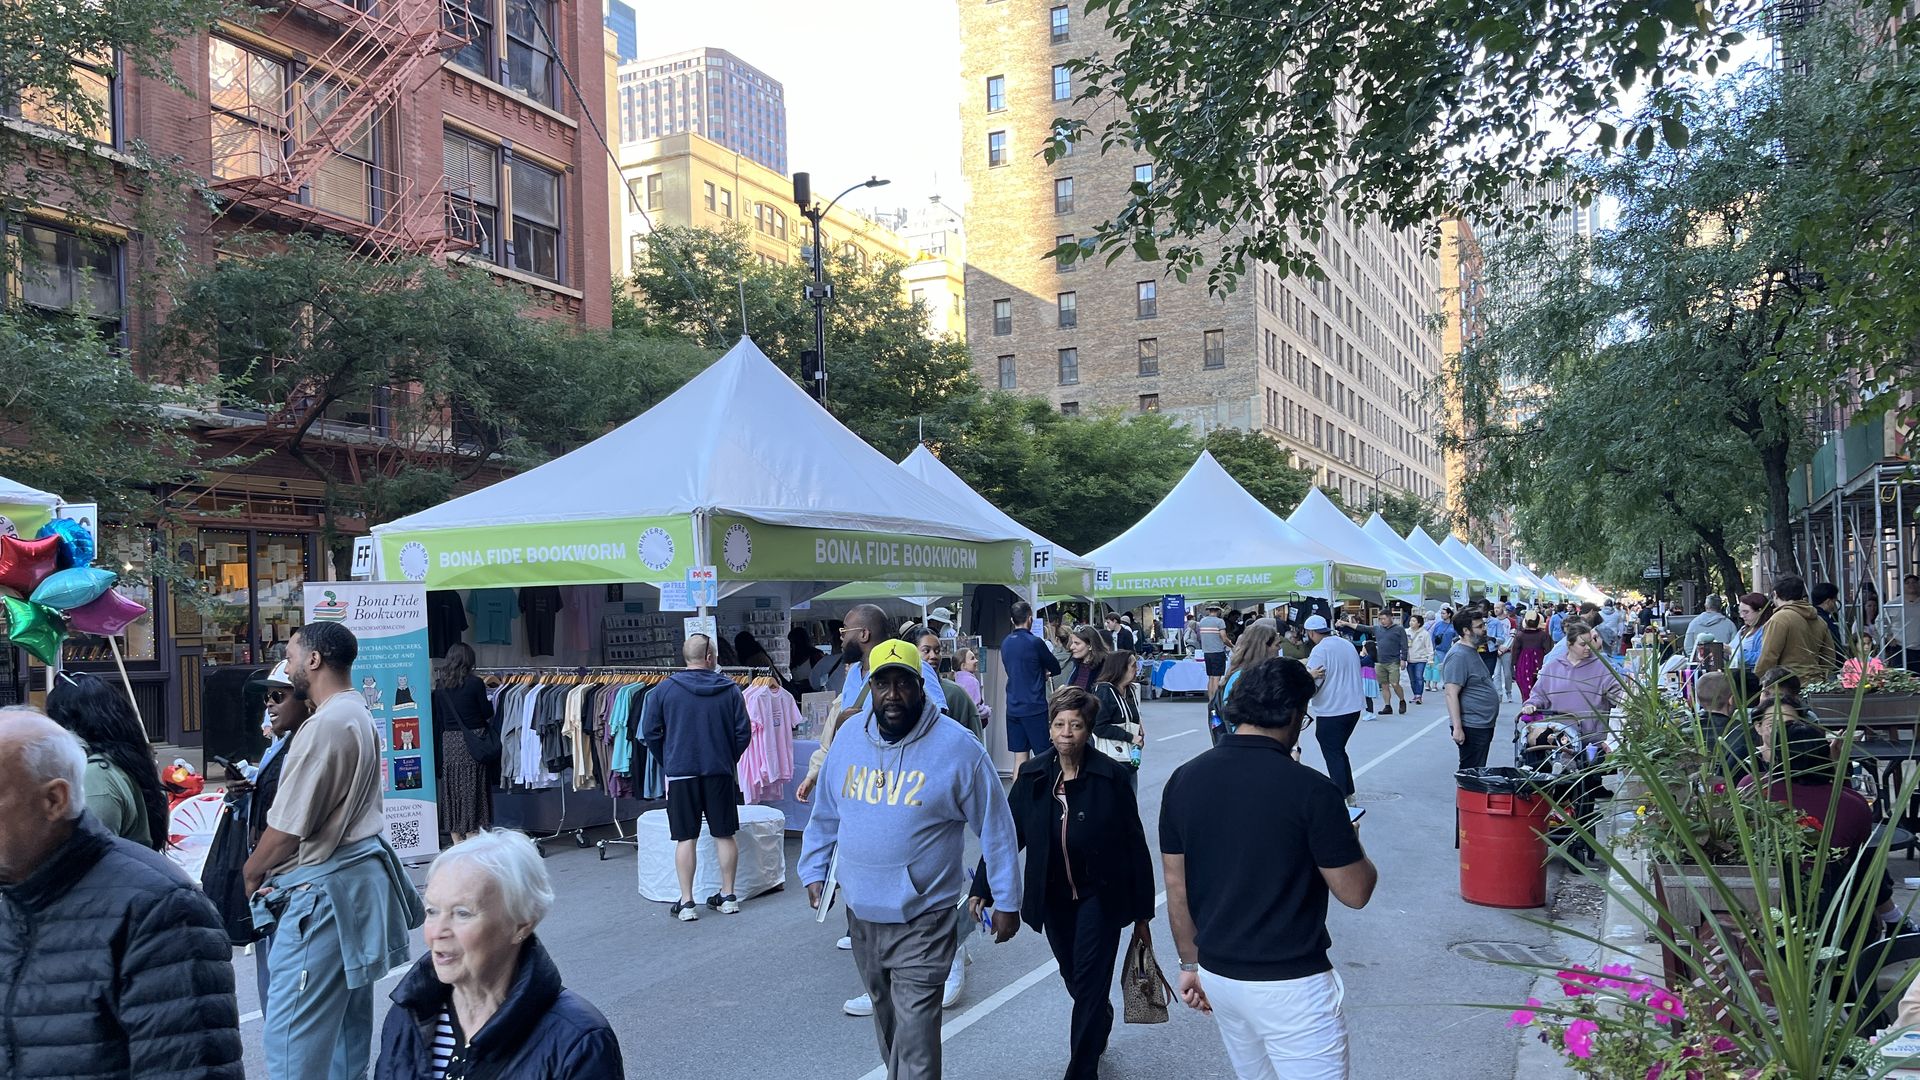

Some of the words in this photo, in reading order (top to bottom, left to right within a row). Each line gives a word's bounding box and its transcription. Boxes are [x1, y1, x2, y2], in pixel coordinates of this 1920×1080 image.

[639, 527, 663, 554] PRINTERS
[664, 534, 674, 553] ROW
[724, 524, 745, 553] PRINTERS
[356, 545, 371, 567] FF
[439, 550, 485, 568] BONA
[487, 548, 523, 565] FIDE
[527, 543, 627, 563] BOOKWORM
[815, 538, 863, 565] BONA
[866, 541, 900, 566] FIDE
[903, 543, 977, 569] BOOKWORM
[1034, 551, 1049, 568] FF
[642, 558, 653, 569] LIT
[655, 557, 671, 570] FEST
[726, 558, 735, 569] LIT
[736, 558, 749, 572] FEST
[1097, 570, 1109, 581] EE
[1116, 576, 1178, 590] LITERARY
[1180, 575, 1213, 587] HALL
[1216, 574, 1233, 585] OF
[1236, 572, 1272, 584] FAME
[1386, 579, 1398, 588] DD
[357, 595, 389, 607] Bona
[392, 594, 420, 607] Fide
[354, 607, 420, 620] Bookworm
[841, 764, 927, 806] MOV2
[386, 805, 411, 813] FOLLOW
